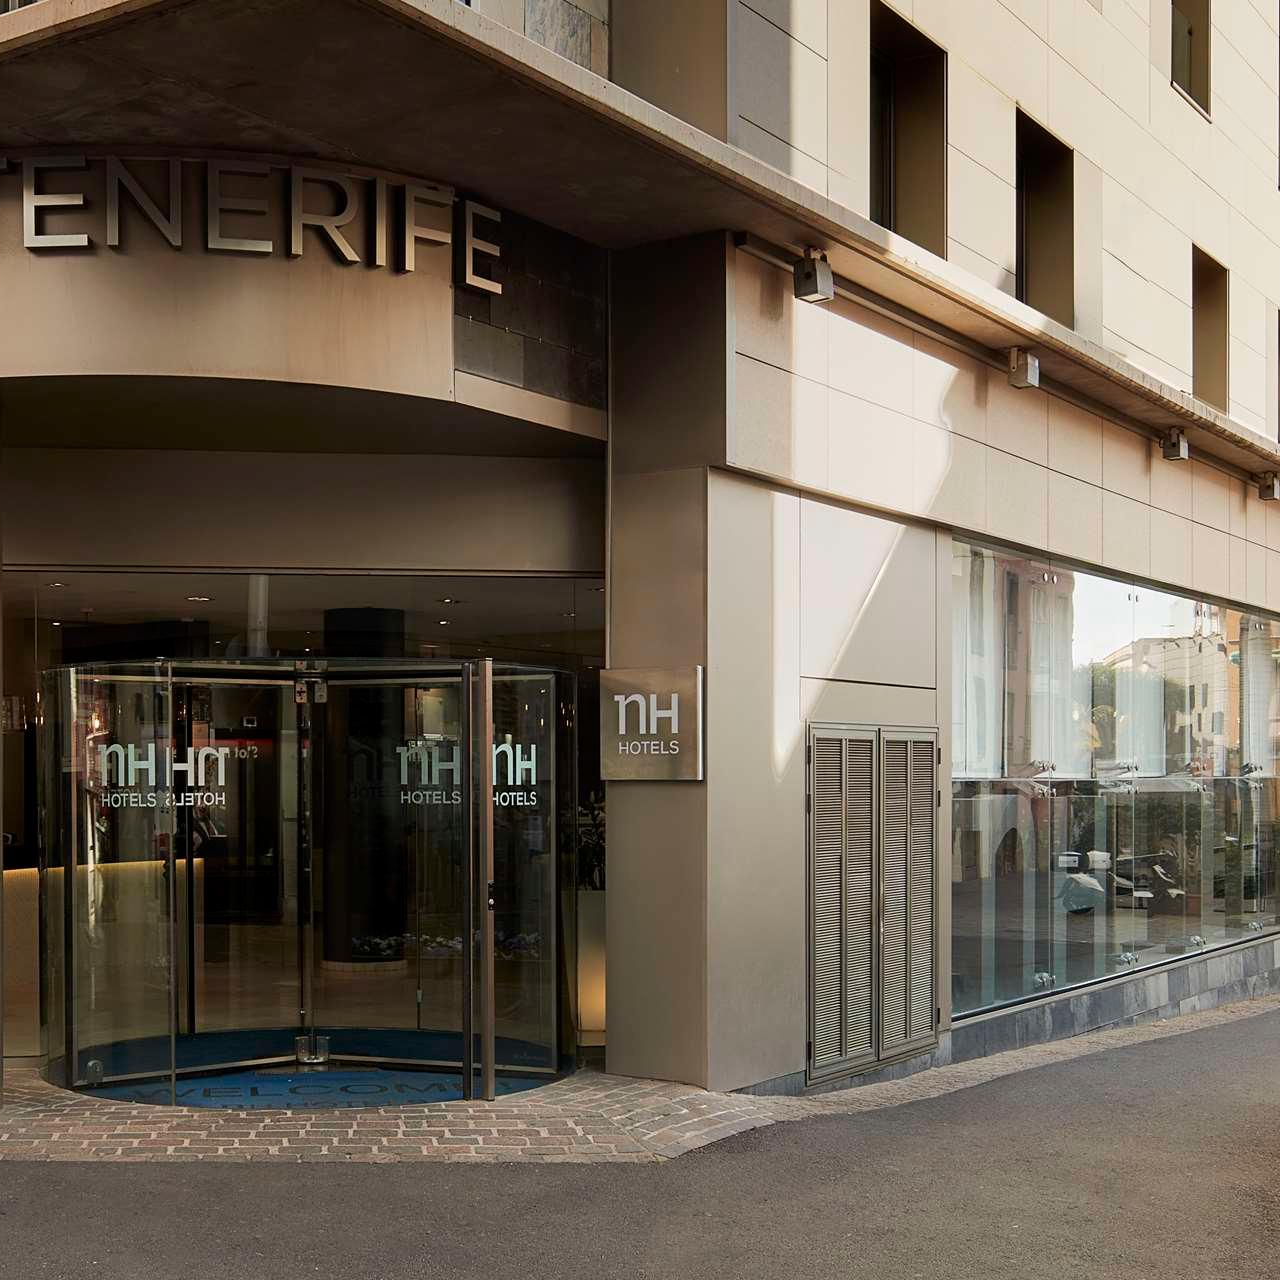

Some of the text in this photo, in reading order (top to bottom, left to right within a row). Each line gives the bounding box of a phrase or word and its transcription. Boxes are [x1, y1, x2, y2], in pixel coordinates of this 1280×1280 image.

[619, 741, 680, 755] HOTELS
[101, 792, 157, 808] HOTELS
[400, 791, 462, 804] HOTELS
